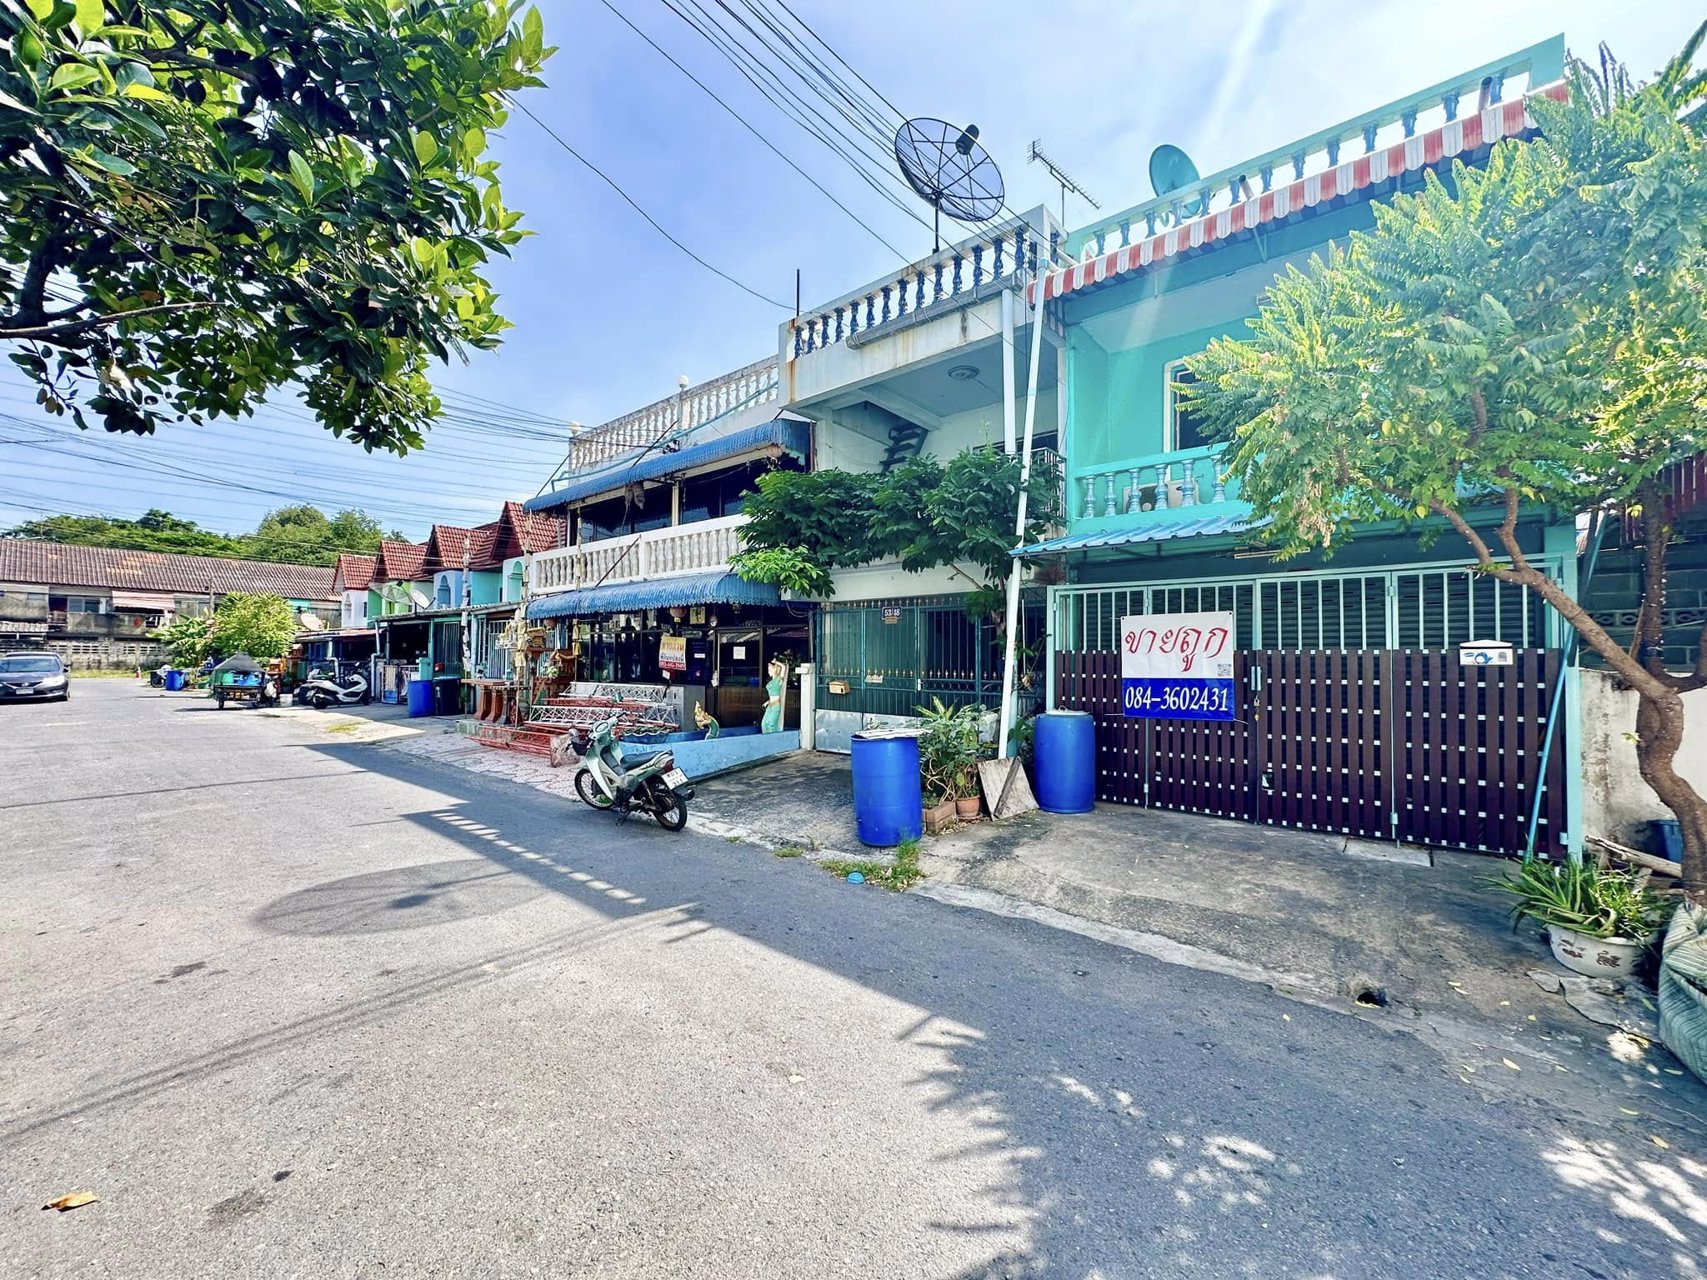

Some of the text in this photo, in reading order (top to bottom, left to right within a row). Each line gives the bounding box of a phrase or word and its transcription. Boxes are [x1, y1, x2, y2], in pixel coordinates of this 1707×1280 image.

[1125, 626, 1228, 672] ขายถูก
[1125, 686, 1228, 711] 084-3602431
